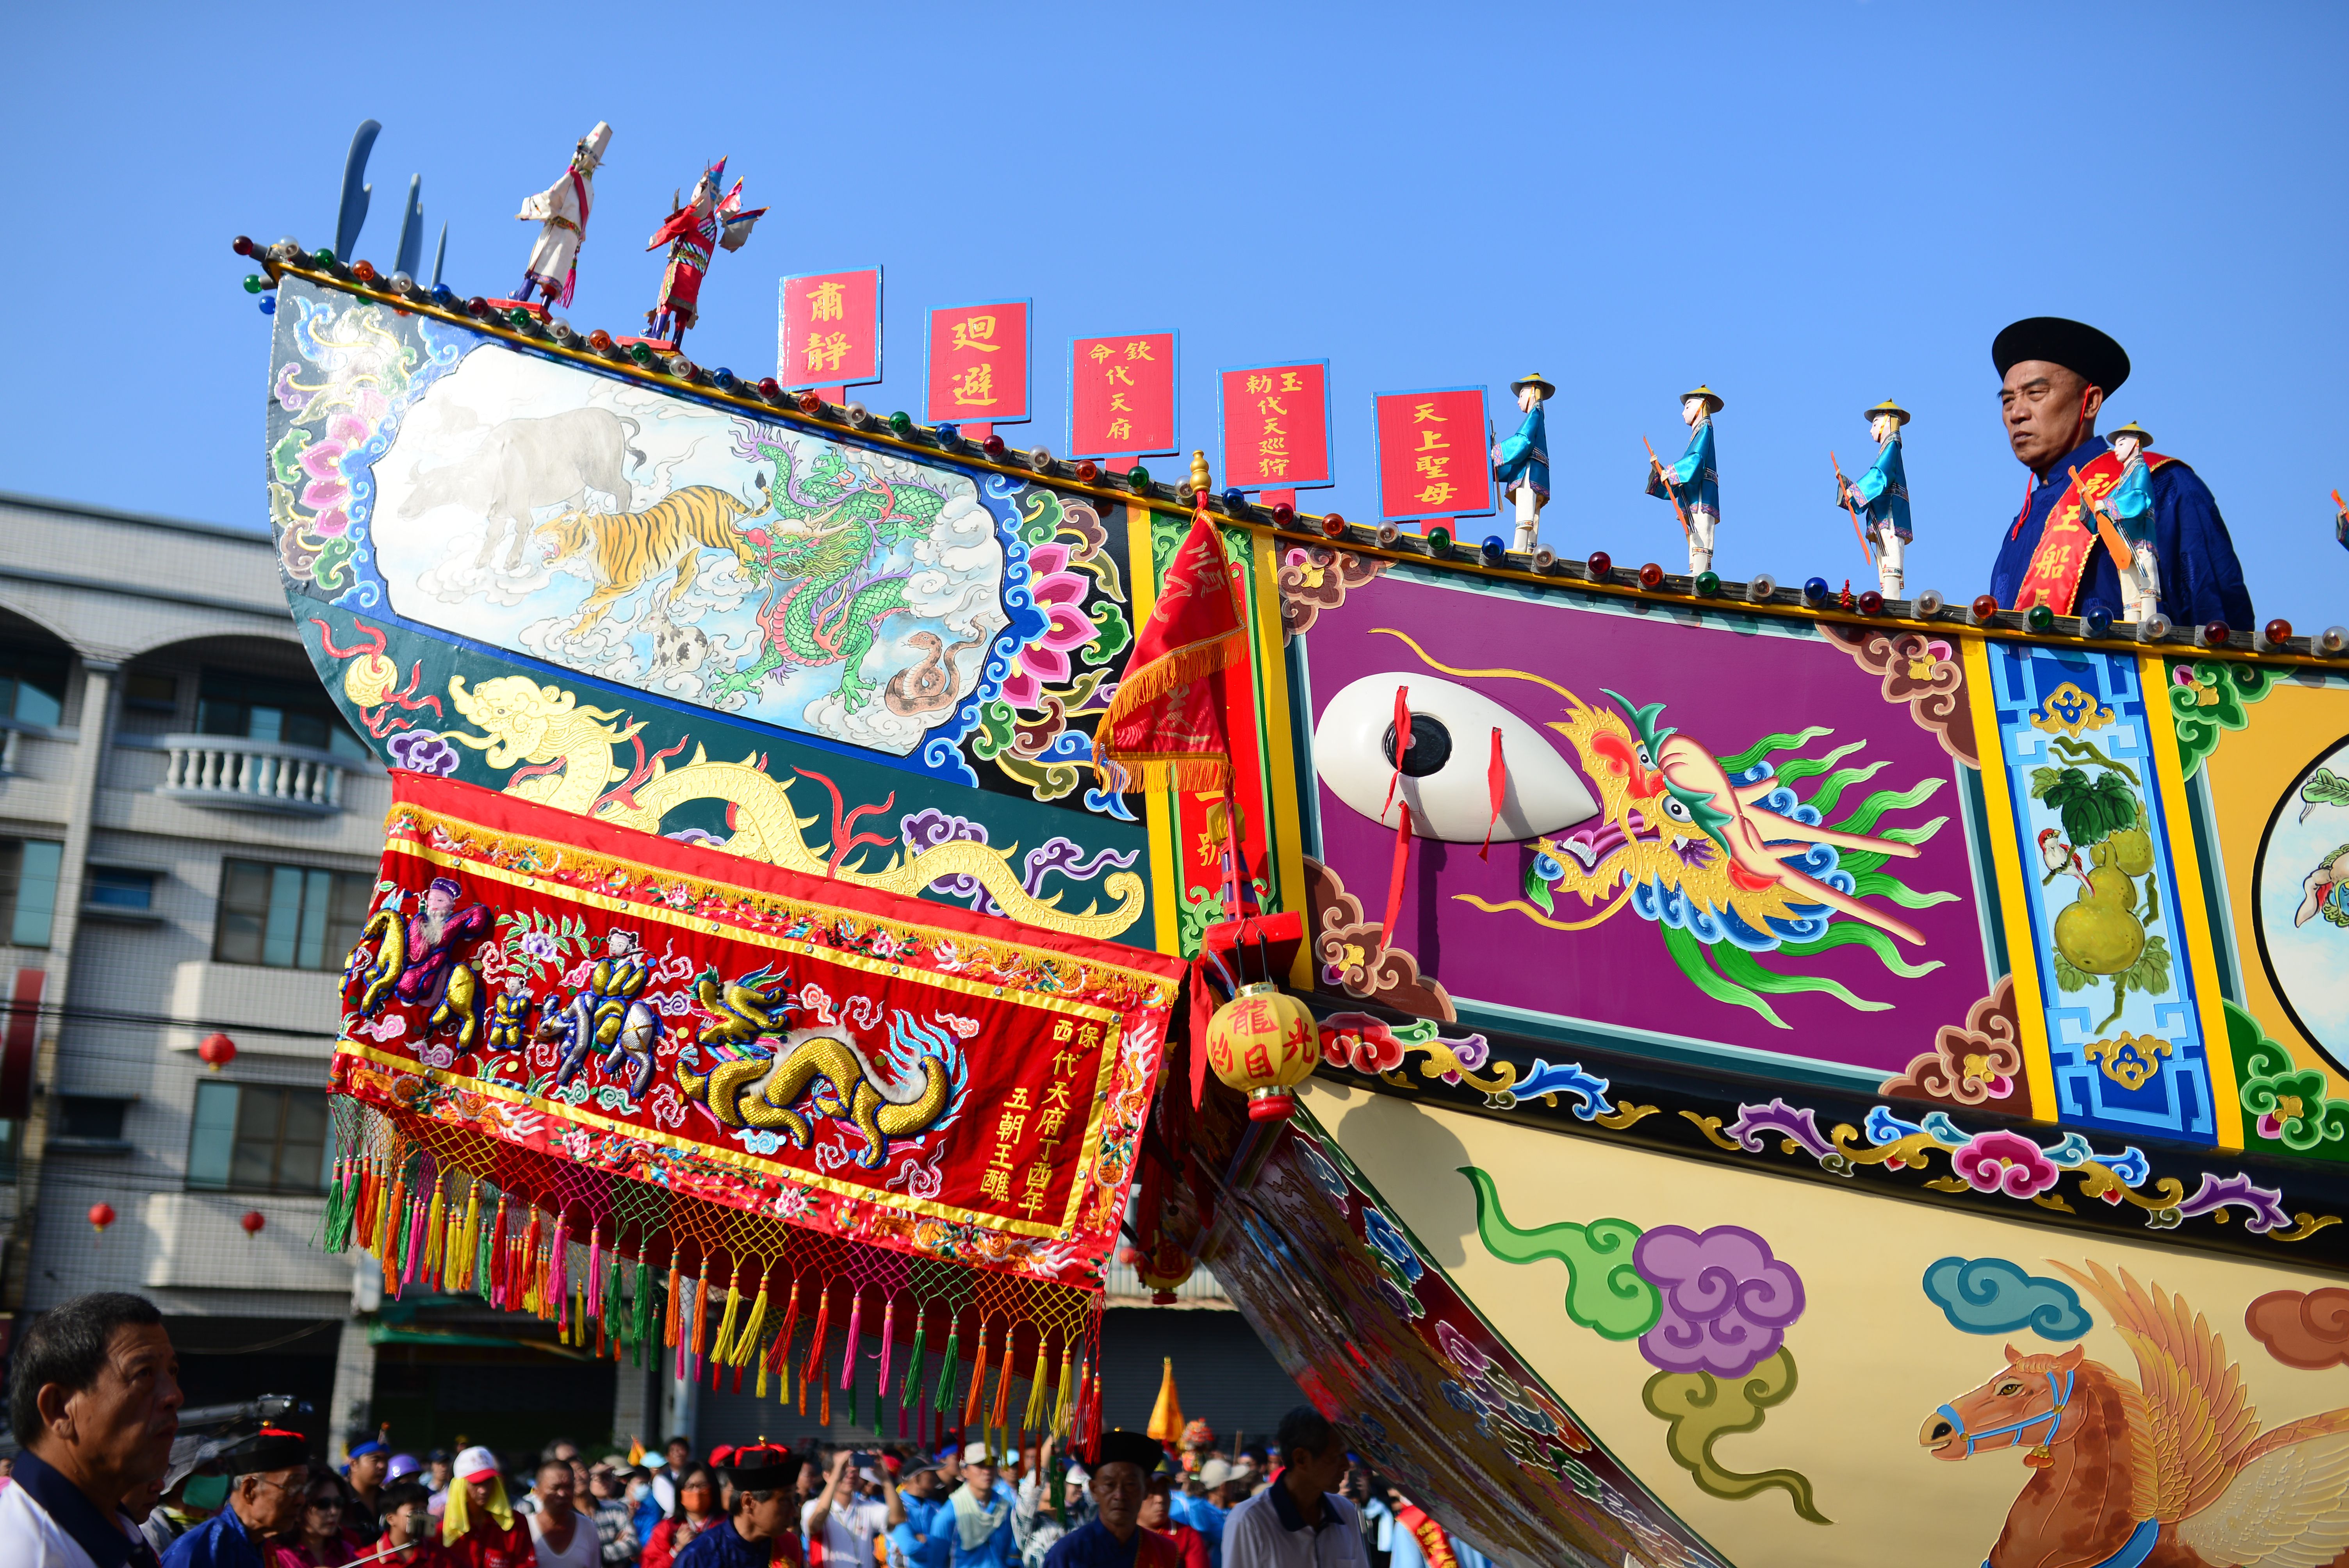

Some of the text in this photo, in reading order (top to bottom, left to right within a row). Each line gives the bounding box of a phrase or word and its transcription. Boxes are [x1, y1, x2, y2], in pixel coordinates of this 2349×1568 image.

[802, 281, 852, 372] 肅靜
[1412, 402, 1458, 505] 天上聖母
[979, 1087, 1032, 1202] 五朝王醮
